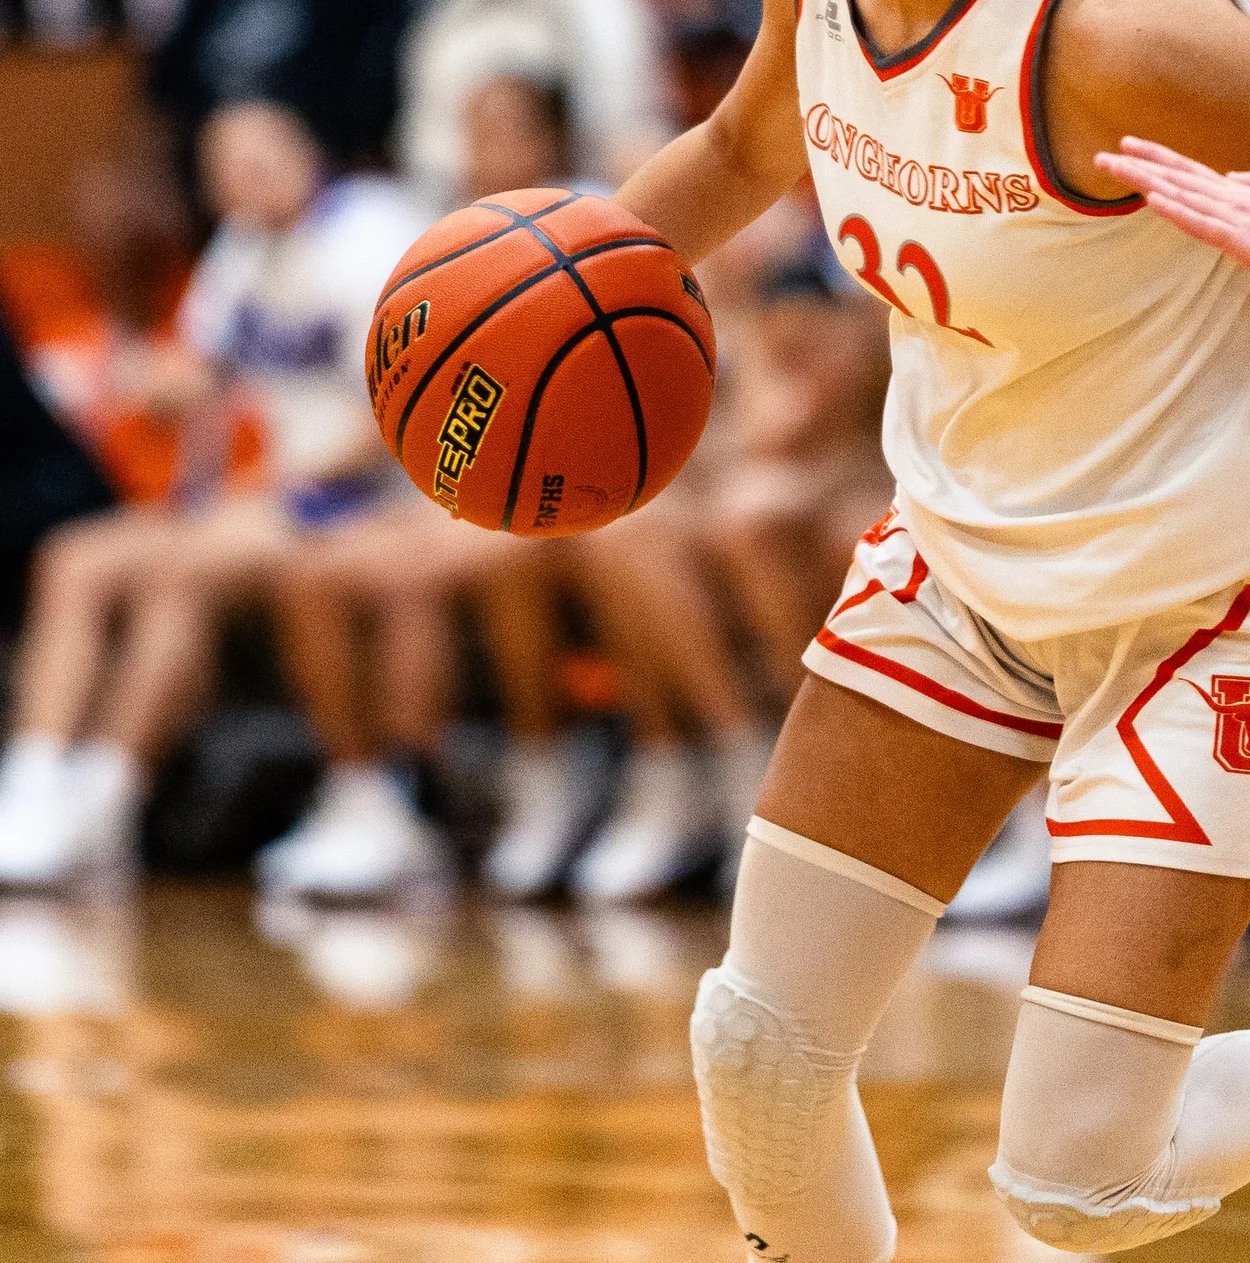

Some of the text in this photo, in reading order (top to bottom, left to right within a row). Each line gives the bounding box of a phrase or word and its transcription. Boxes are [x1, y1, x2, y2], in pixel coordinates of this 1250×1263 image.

[801, 102, 1039, 214] ONGHORNS
[368, 299, 431, 418] den
[434, 364, 506, 518] ITEPRO
